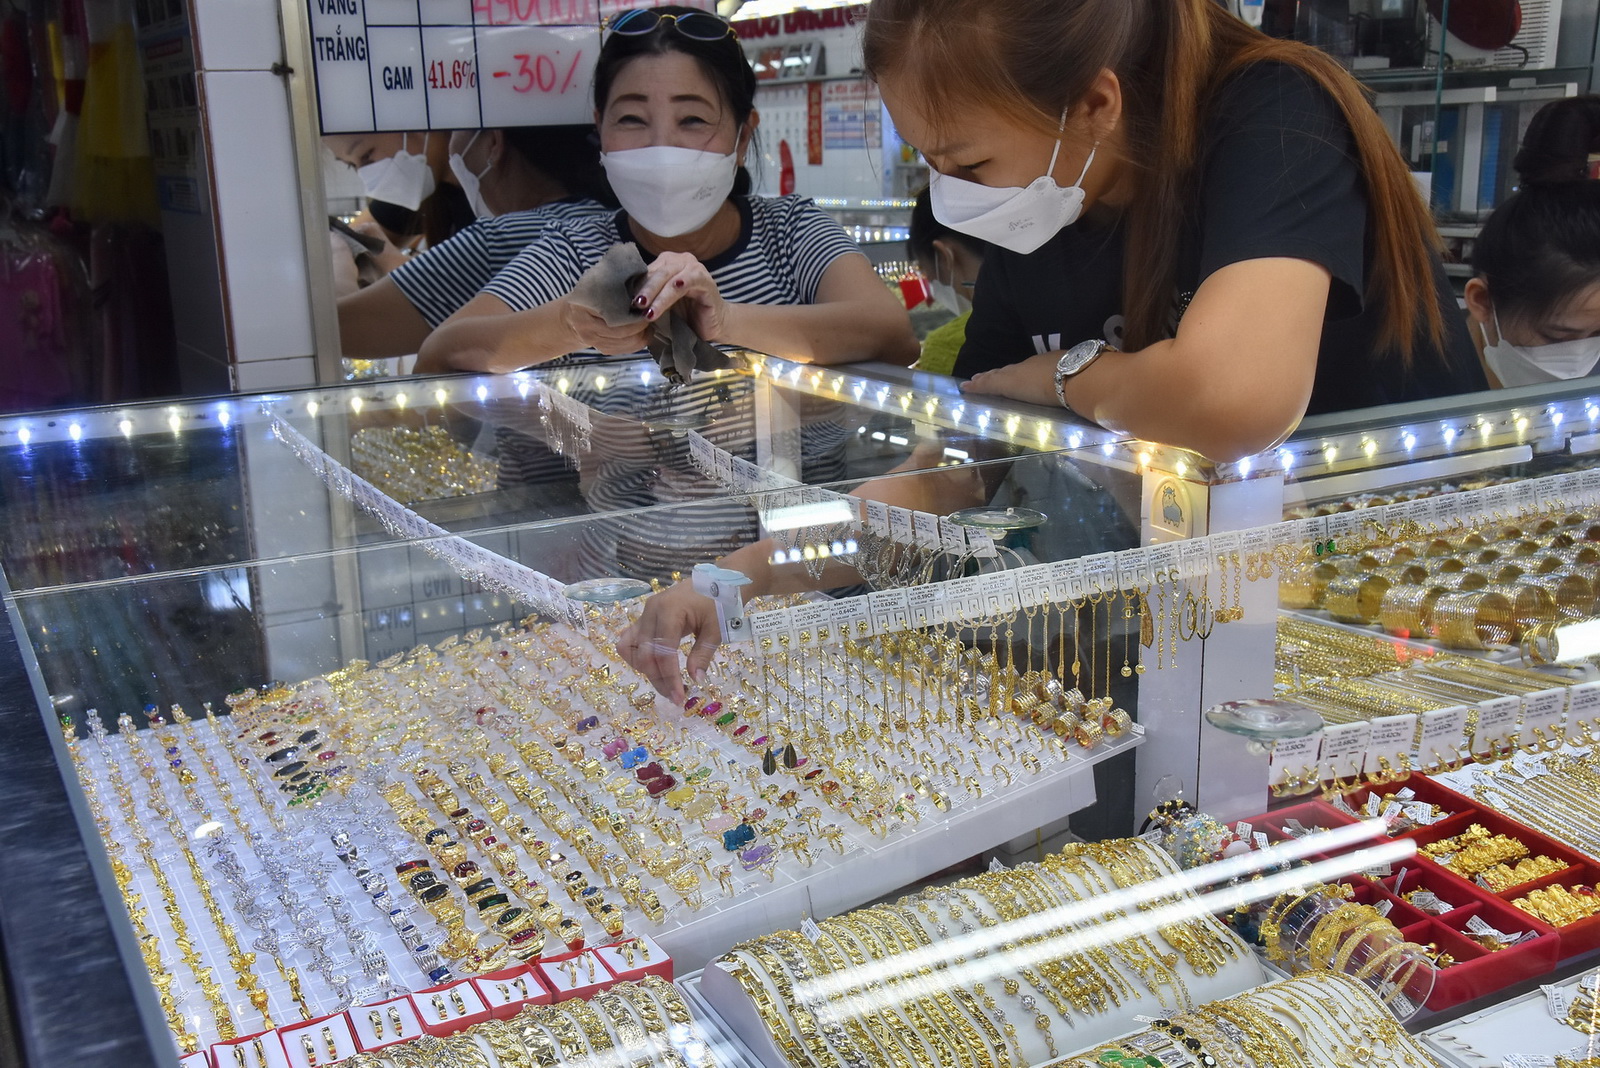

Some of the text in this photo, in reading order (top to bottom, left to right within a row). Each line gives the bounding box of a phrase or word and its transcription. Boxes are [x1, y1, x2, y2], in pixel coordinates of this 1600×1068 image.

[316, 25, 366, 61] TRẮNG
[383, 66, 414, 90] GAM
[428, 59, 477, 89] 41.6%
